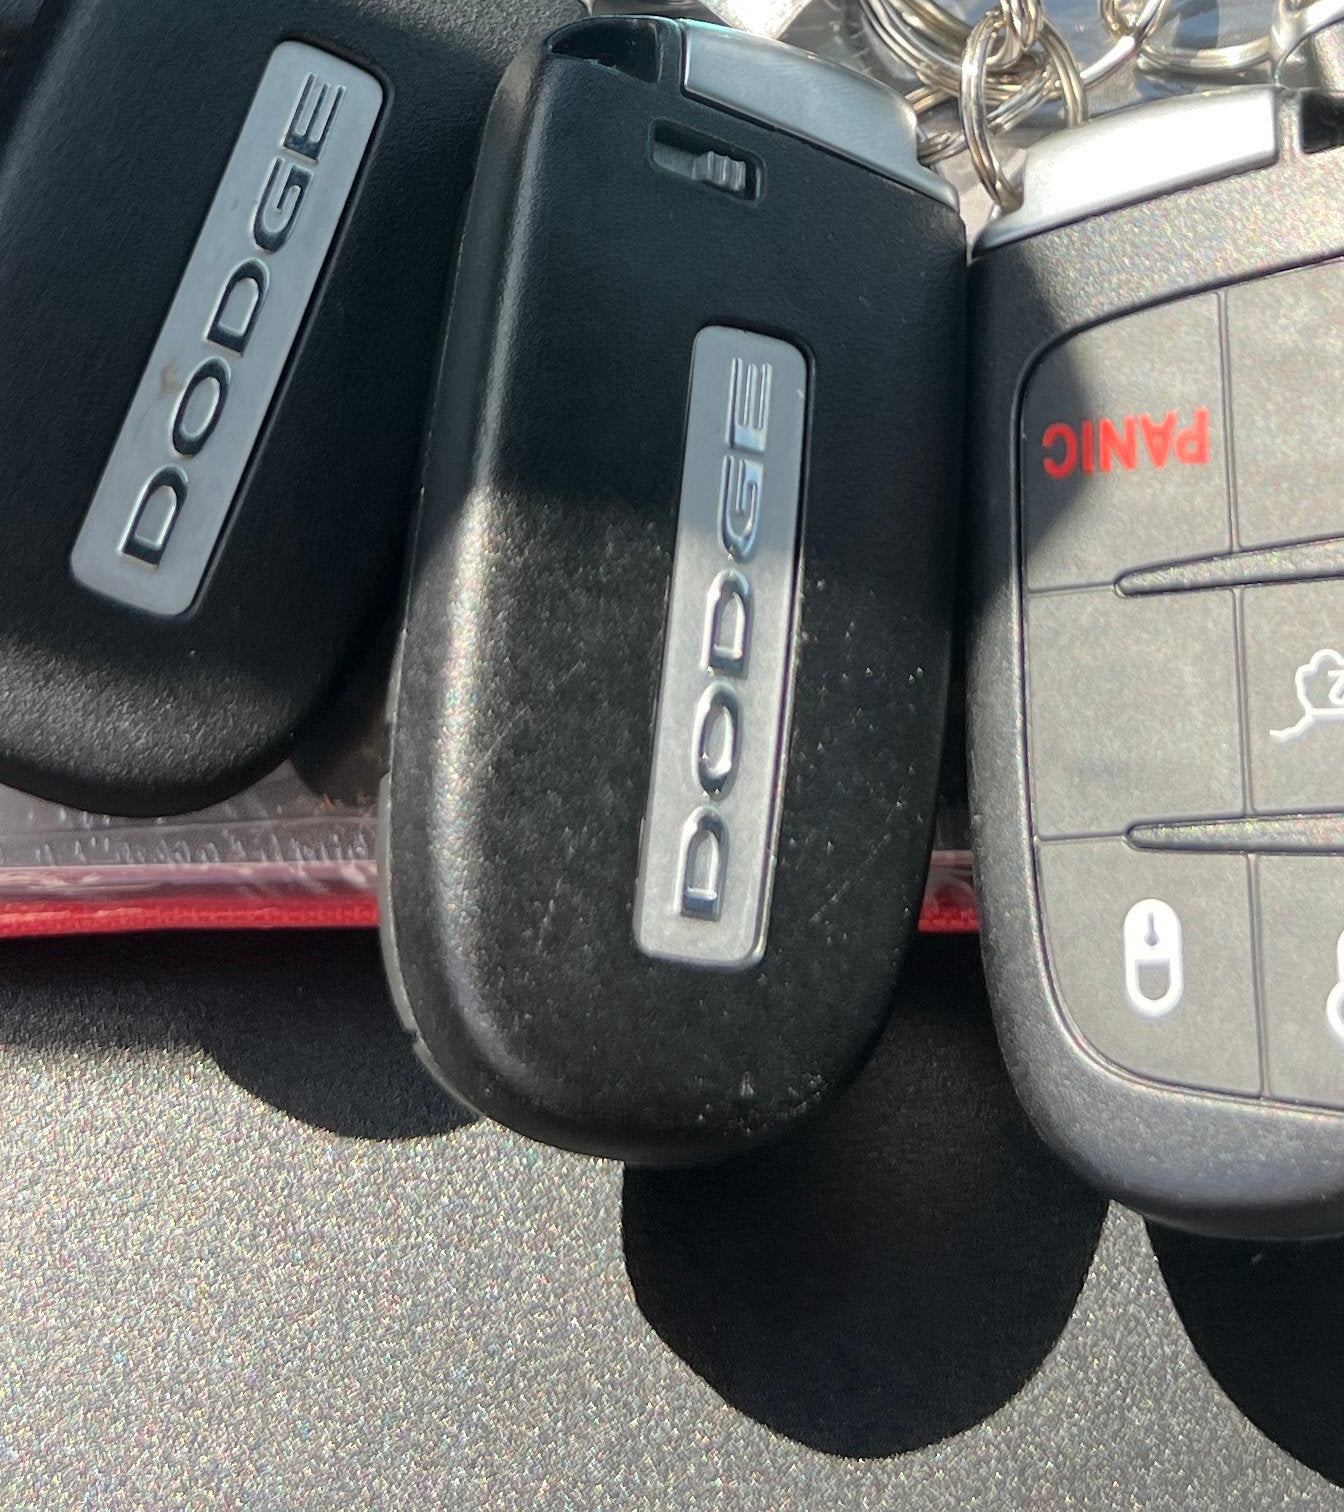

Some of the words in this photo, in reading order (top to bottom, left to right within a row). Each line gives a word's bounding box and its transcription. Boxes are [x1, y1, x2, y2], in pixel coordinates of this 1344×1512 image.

[119, 72, 346, 567] DODGE
[1041, 408, 1211, 476] PANIC
[679, 357, 772, 919] DODGE
